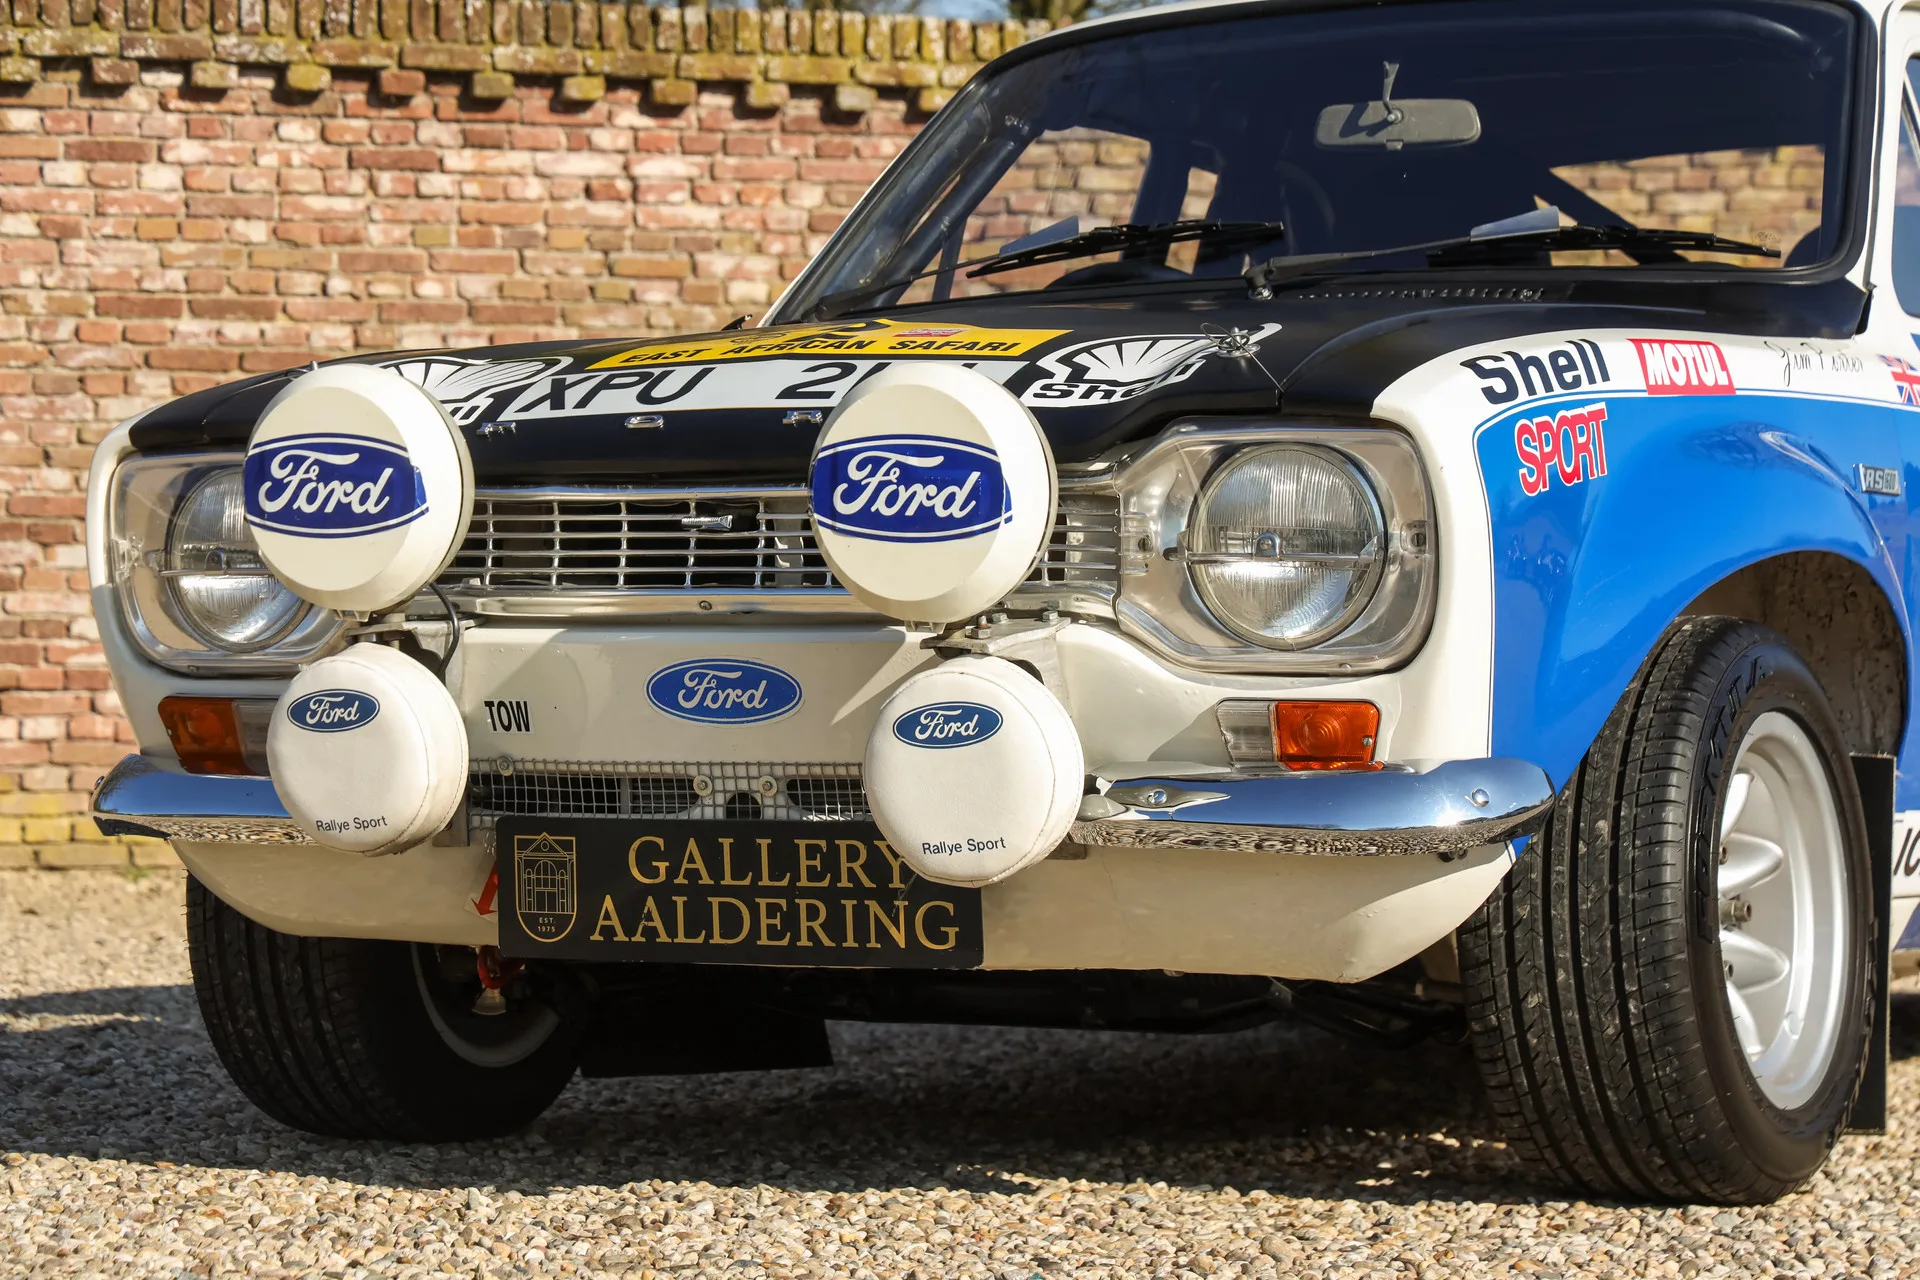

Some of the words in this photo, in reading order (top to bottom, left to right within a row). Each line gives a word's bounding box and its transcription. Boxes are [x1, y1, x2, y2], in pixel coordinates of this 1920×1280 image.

[619, 348, 712, 363] EAST
[720, 339, 876, 356] AFRICAN
[888, 340, 1021, 352] SAFARI
[1459, 338, 1611, 405] Shell
[1641, 341, 1730, 388] MOTUL
[513, 366, 717, 413] XPU
[1032, 362, 1197, 401] Shell
[1515, 403, 1608, 495] SPORT
[258, 449, 394, 514] Ford
[833, 450, 981, 518] Ford
[305, 695, 360, 725] Ford
[677, 668, 768, 711] Ford
[484, 700, 531, 732] TOW
[914, 709, 980, 740] Ford
[315, 818, 350, 834] Rallye
[353, 815, 388, 831] Sport
[922, 840, 963, 856] Rallye
[966, 836, 1007, 854] Sport
[628, 835, 905, 889] GALLERY
[589, 894, 960, 951] AALDERING
